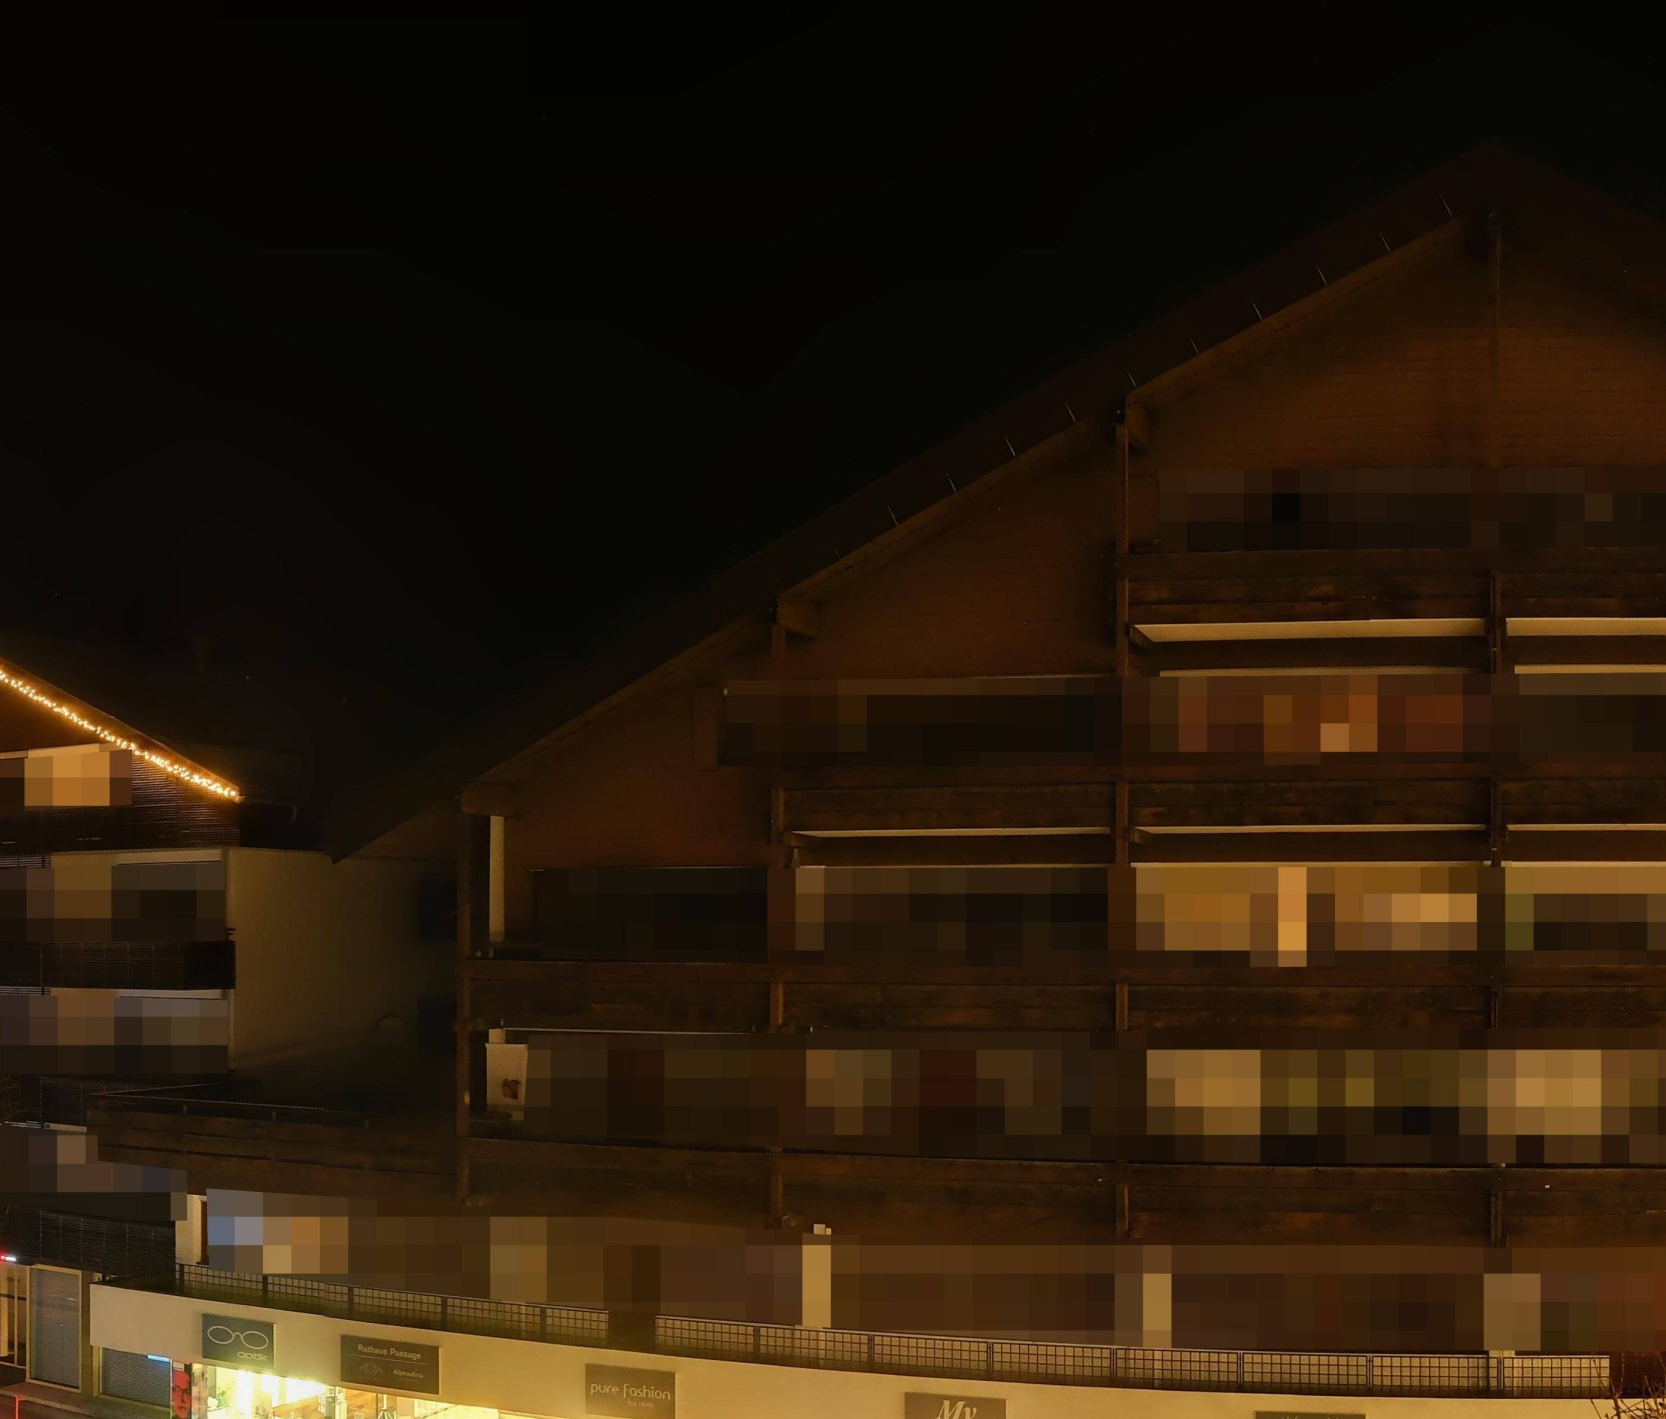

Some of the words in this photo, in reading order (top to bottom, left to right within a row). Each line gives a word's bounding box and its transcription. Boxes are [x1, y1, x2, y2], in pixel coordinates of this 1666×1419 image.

[236, 1351, 268, 1363] optik
[357, 1343, 388, 1356] Rathaus
[389, 1347, 422, 1361] Passage
[590, 1383, 620, 1395] pure
[623, 1384, 671, 1400] fashion
